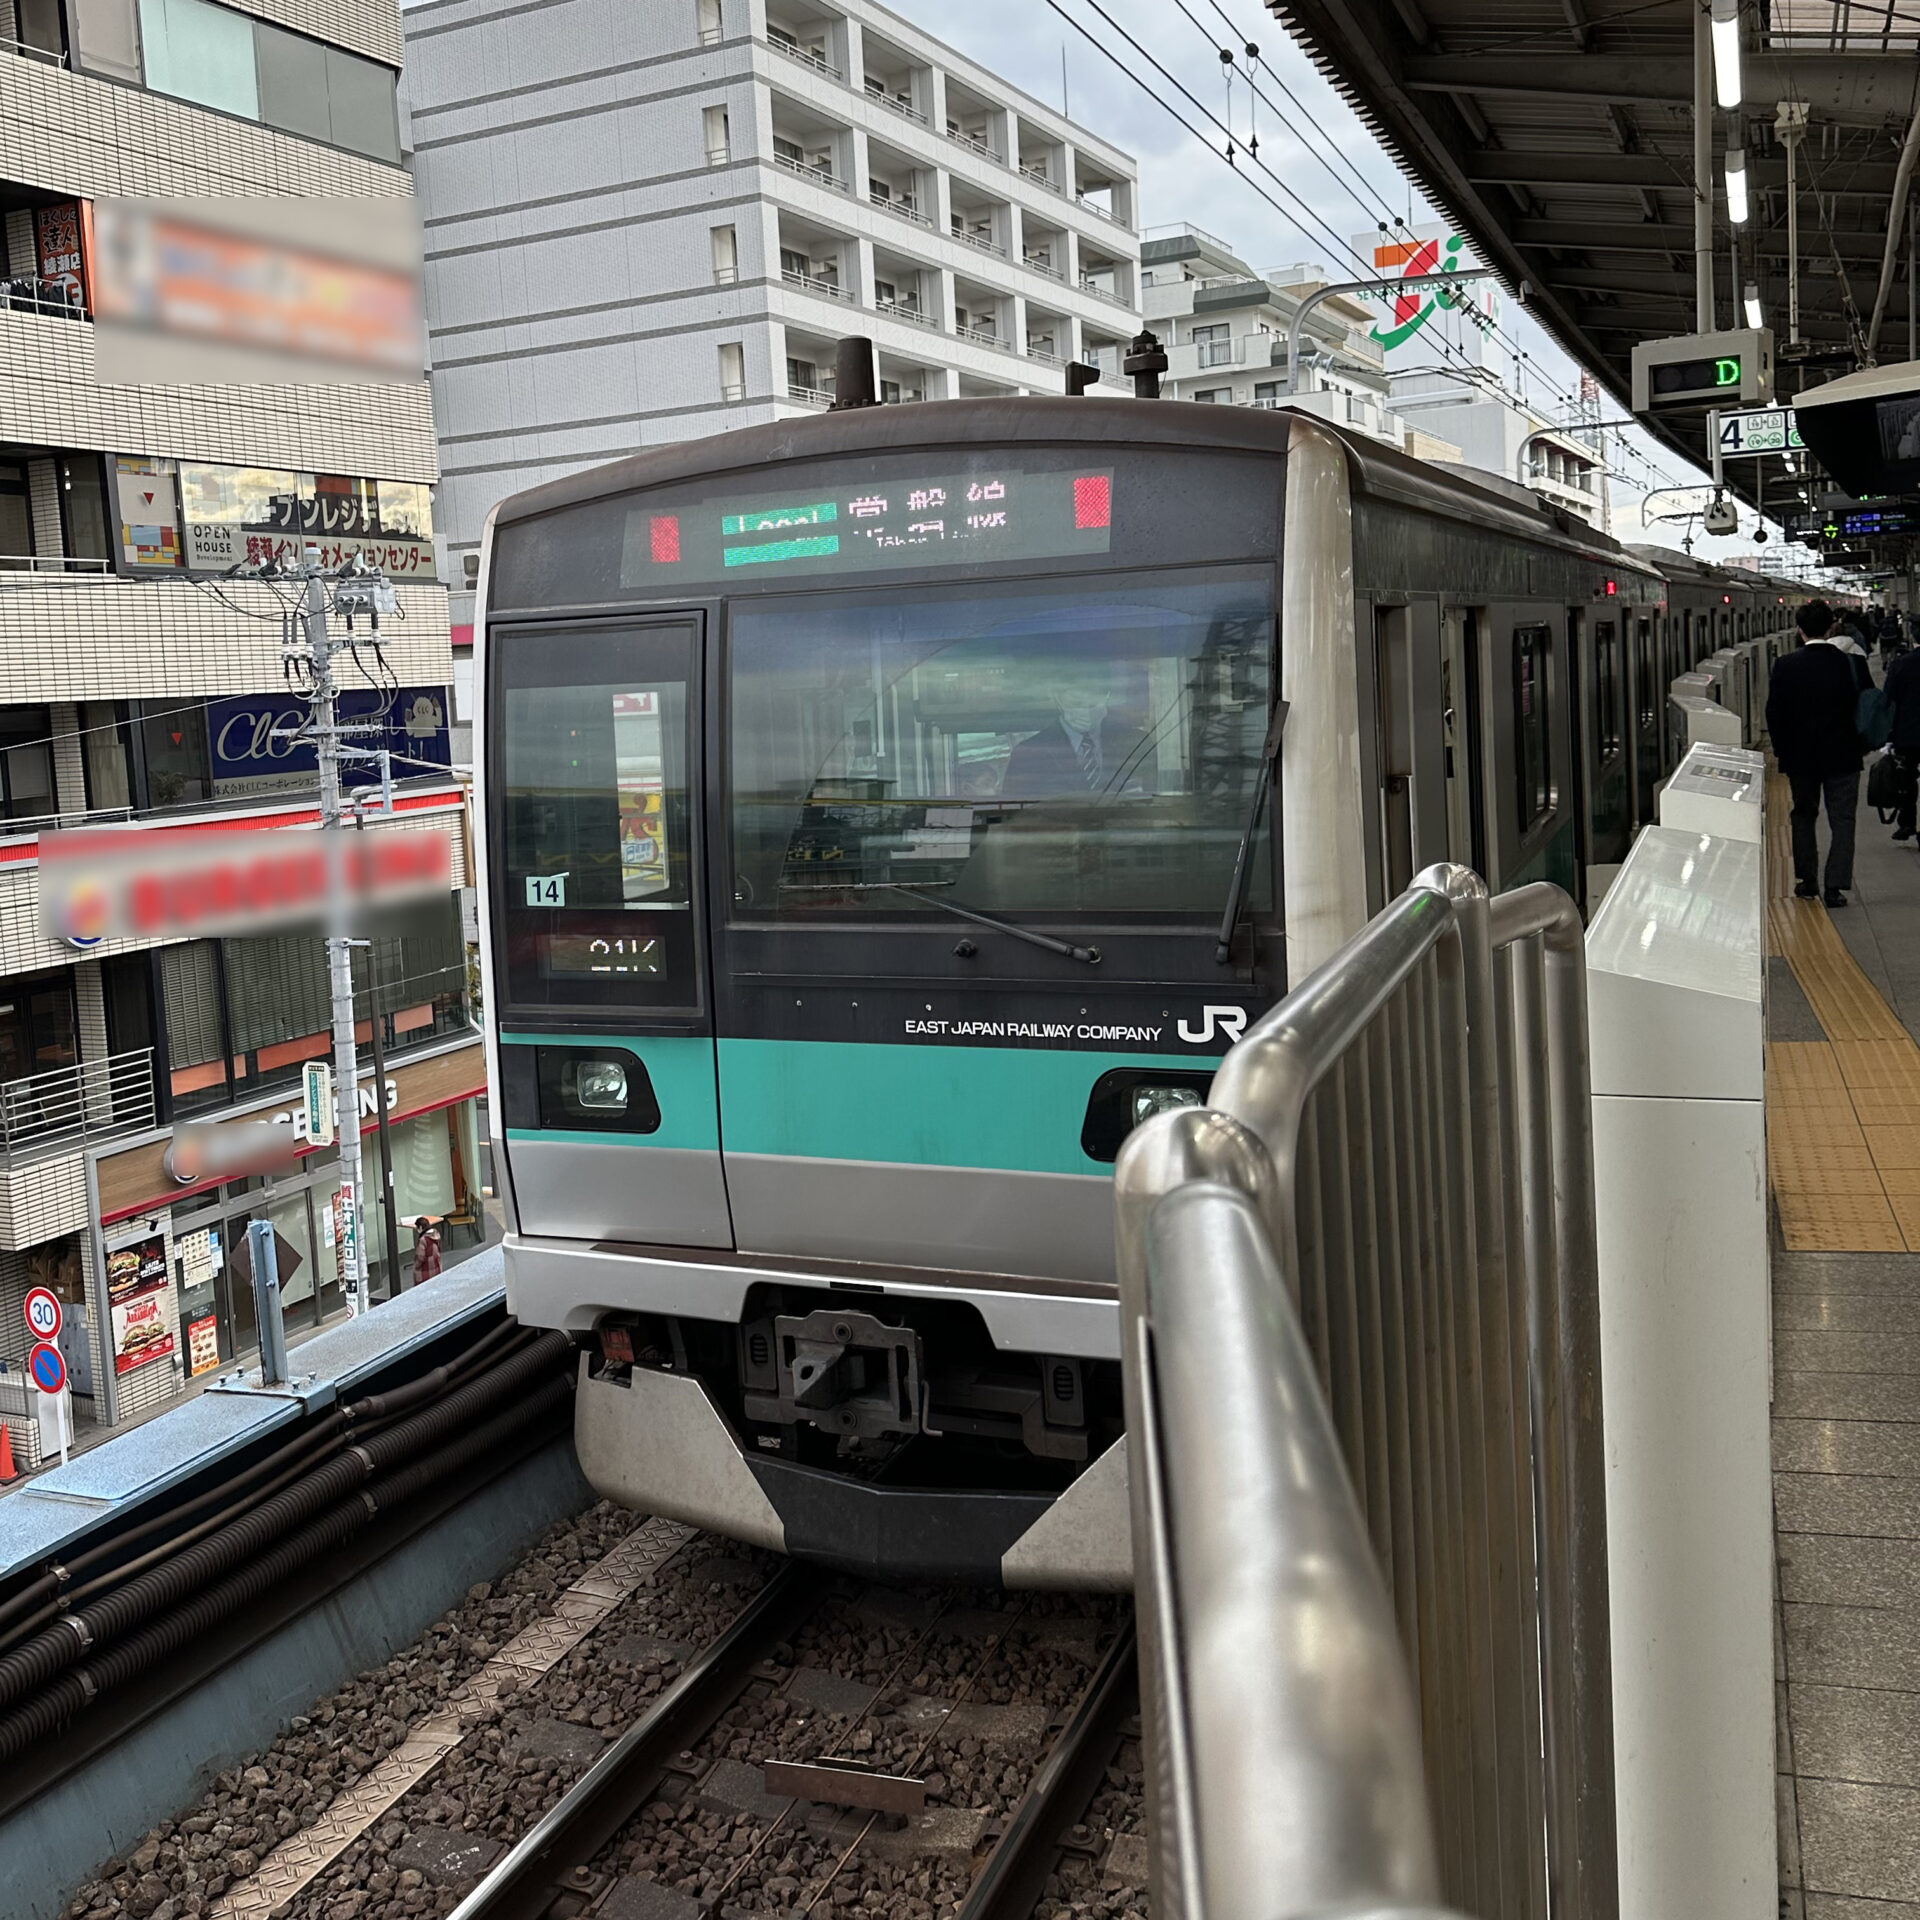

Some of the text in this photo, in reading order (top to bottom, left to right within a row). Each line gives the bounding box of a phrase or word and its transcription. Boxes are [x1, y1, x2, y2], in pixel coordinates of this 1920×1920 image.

[43, 252, 80, 275] 綾瀬店
[1716, 361, 1739, 385] D
[1720, 419, 1743, 449] 4
[193, 525, 231, 539] OPEN
[195, 541, 232, 553] HOUSE
[246, 536, 431, 572] 綾瀬インォメーョンセンター
[532, 880, 560, 903] 14
[905, 1005, 1248, 1044] EAST JAPAN RAILWAY COMPANY JR
[33, 1302, 54, 1326] 30
